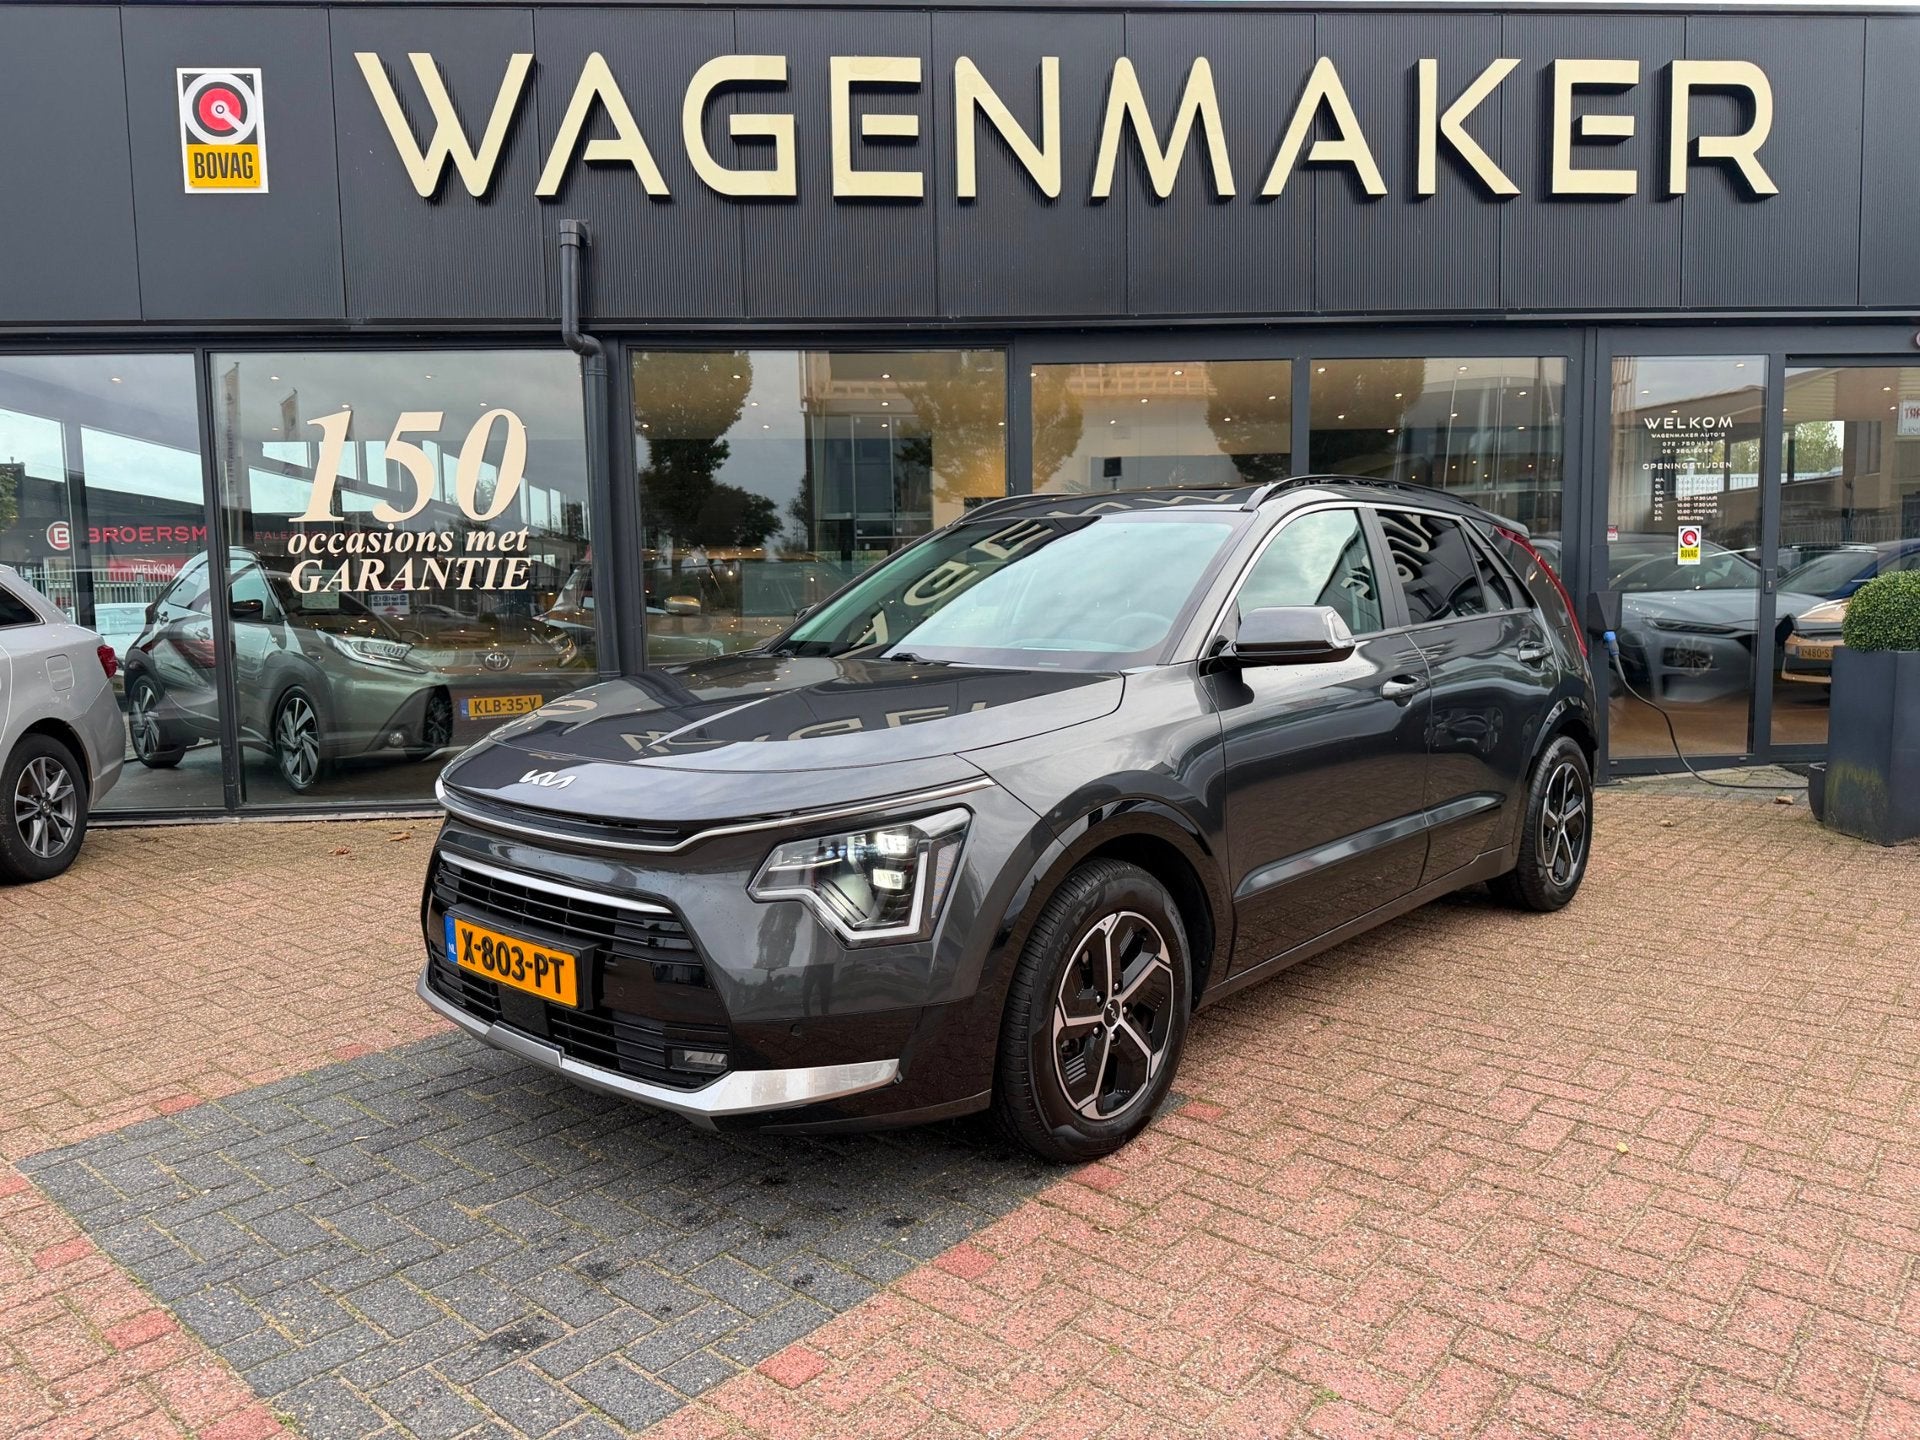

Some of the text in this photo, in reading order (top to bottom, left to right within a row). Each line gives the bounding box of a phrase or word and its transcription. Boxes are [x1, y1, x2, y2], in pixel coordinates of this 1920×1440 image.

[354, 52, 1779, 197] WAGENMAKER
[193, 151, 254, 179] BOVAG
[1644, 416, 1733, 430] WELKOM
[288, 408, 527, 523] 150
[1642, 461, 1732, 470] OPENINGSTIJDEN
[287, 523, 454, 554] occasions
[466, 526, 530, 552] met
[131, 563, 176, 574] WELKOM
[289, 557, 532, 594] GARANTIE
[474, 697, 537, 714] KLB-35-V
[448, 942, 456, 954] NL
[461, 928, 564, 994] X-803-PT
